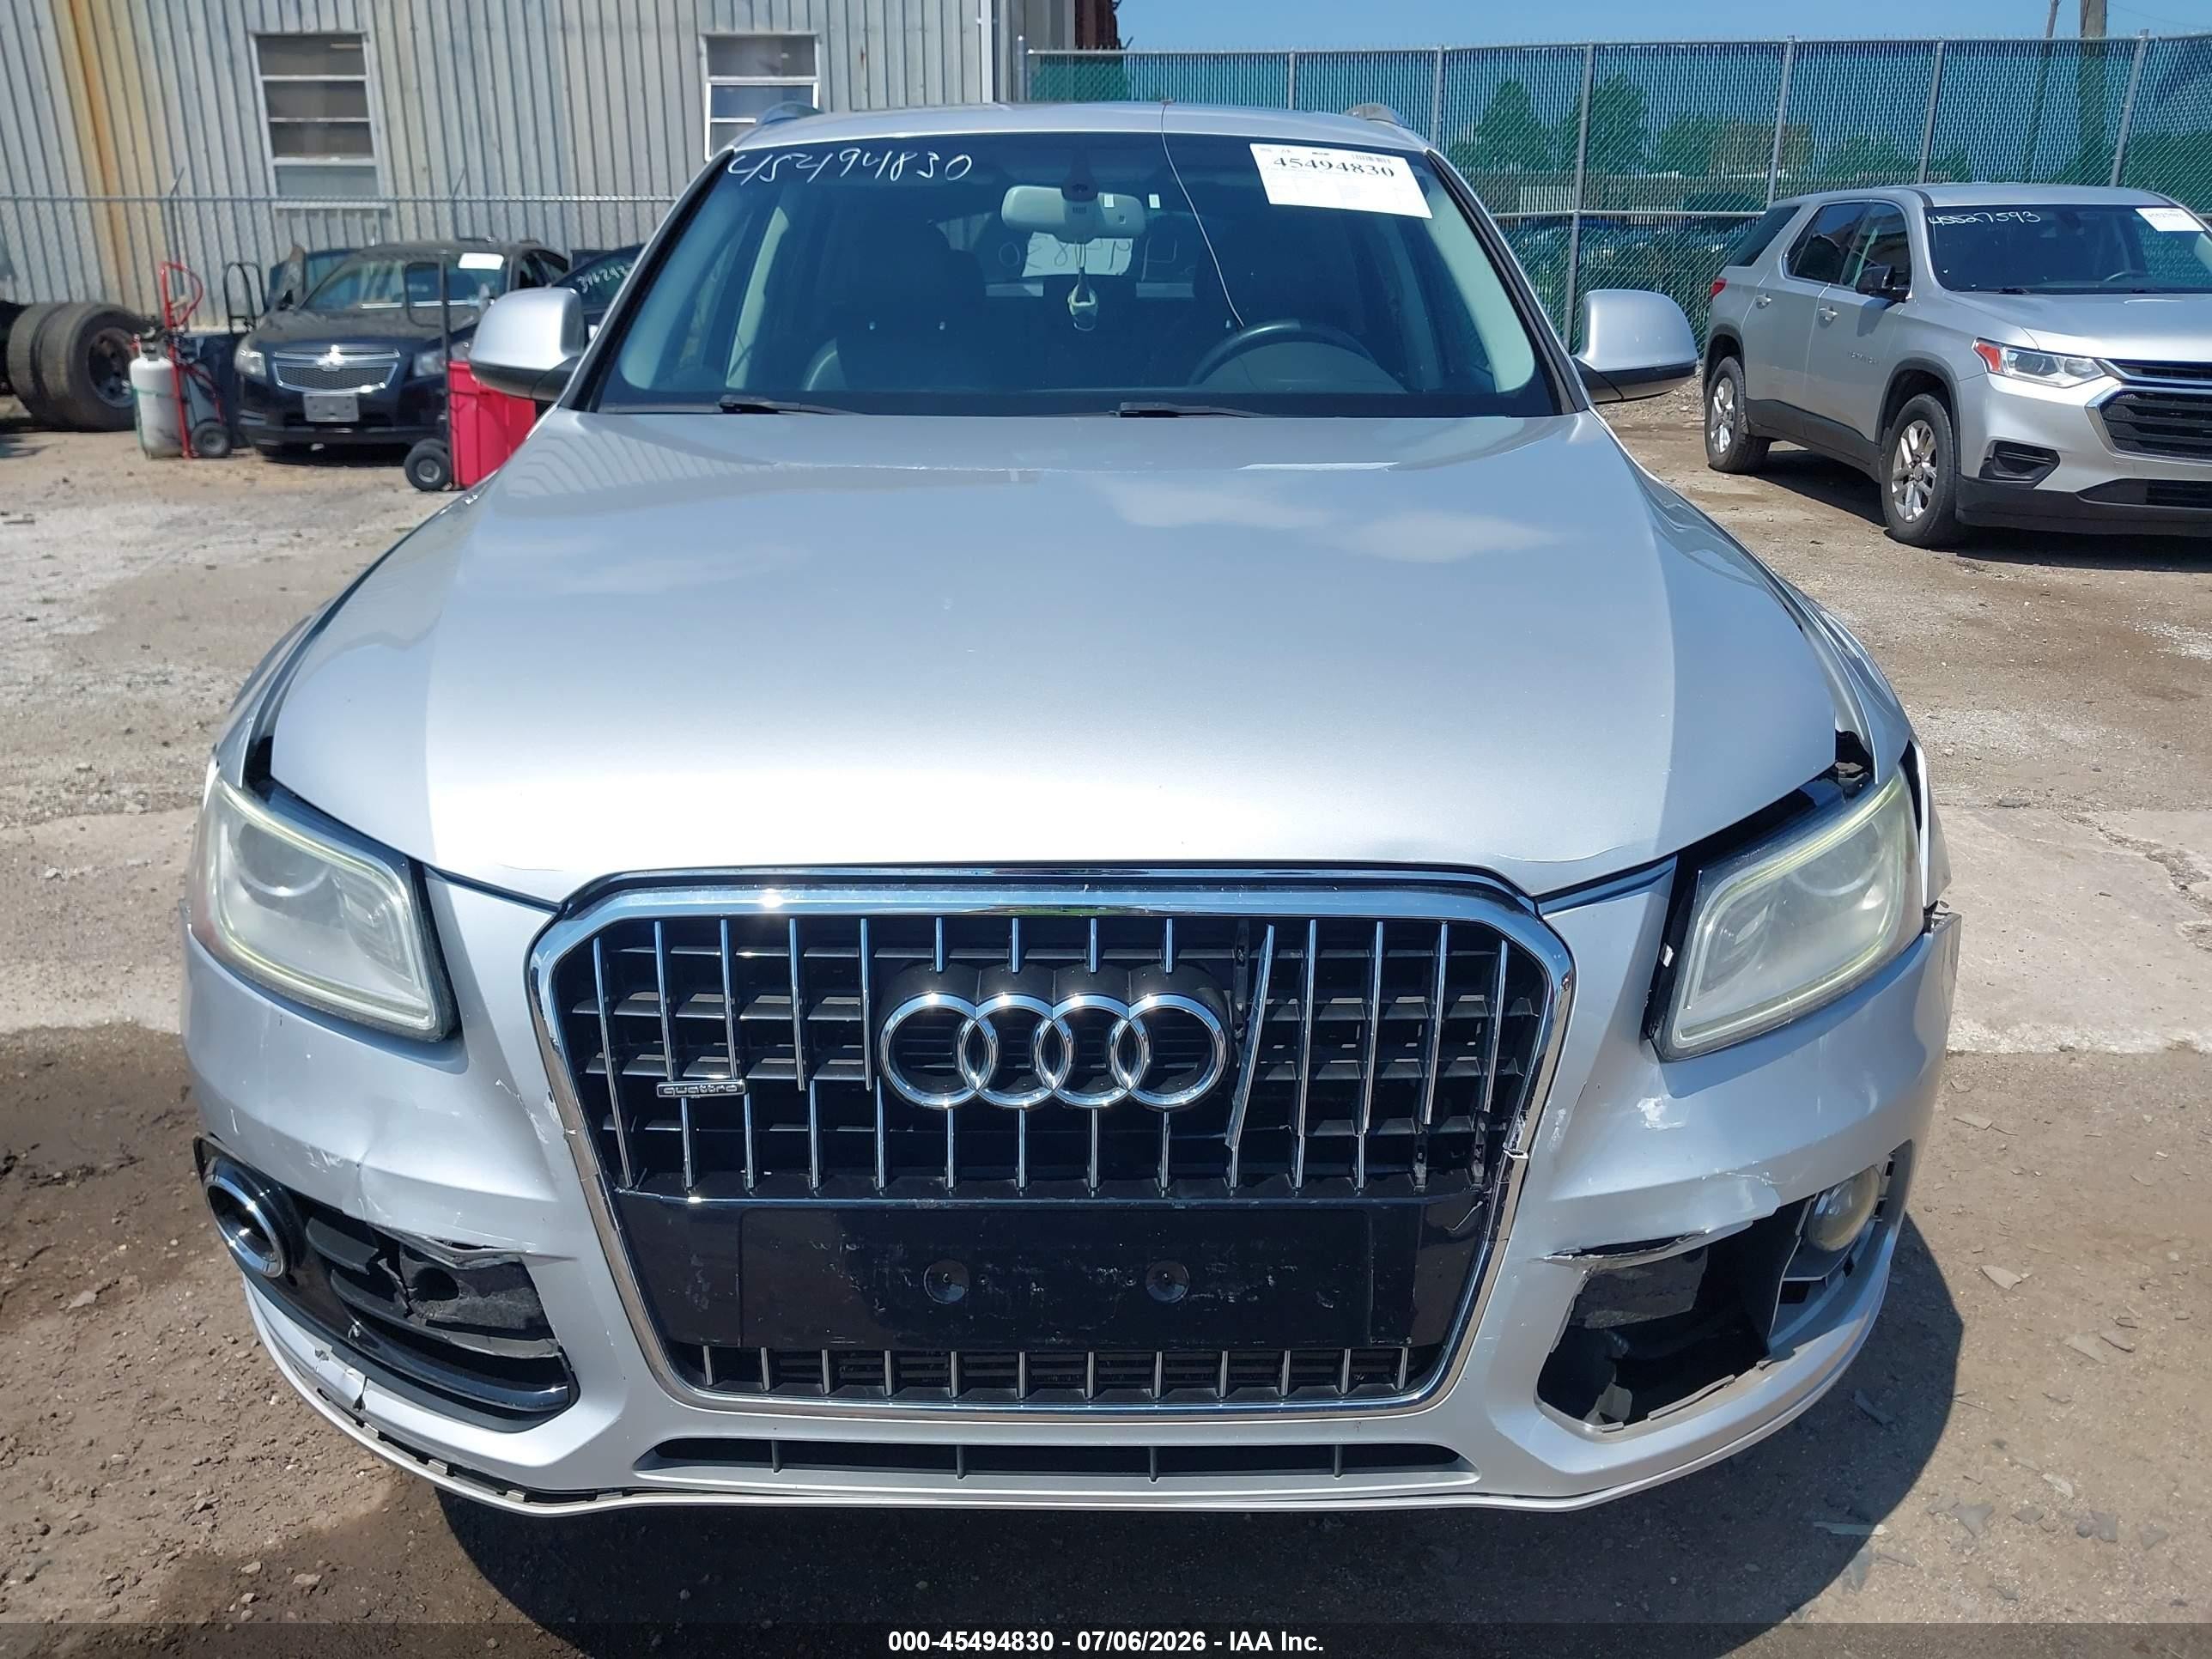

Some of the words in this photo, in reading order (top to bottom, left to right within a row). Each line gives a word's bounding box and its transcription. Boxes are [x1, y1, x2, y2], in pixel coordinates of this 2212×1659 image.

[727, 147, 972, 186] 45494830
[1273, 157, 1395, 179] 45494830
[1927, 210, 2042, 226] 45527593
[661, 1083, 739, 1097] quattro
